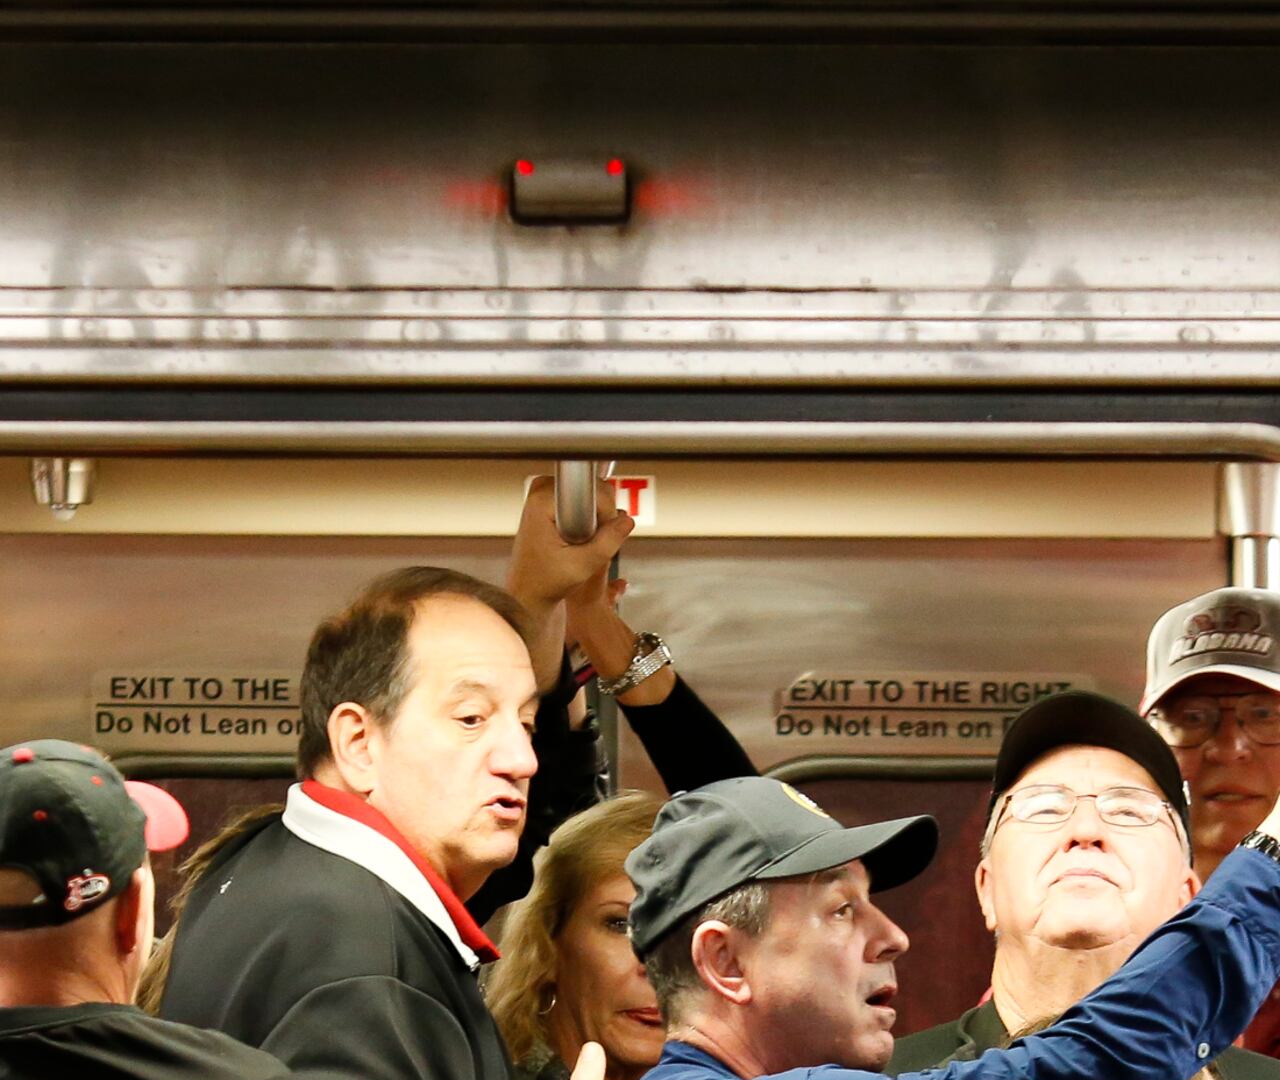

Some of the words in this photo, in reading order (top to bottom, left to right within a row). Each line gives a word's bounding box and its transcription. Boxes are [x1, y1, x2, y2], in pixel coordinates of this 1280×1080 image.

[110, 676, 174, 698] EXIT
[183, 677, 223, 699] TO
[232, 678, 290, 700] THE
[789, 679, 854, 702] EXIT
[864, 680, 904, 702] TO
[914, 681, 971, 703] THE
[95, 711, 133, 734] Do
[143, 712, 191, 734] Not
[201, 713, 267, 735] Lean
[775, 714, 813, 736] Do
[823, 714, 870, 737] Not
[880, 715, 948, 738] Lean
[956, 720, 992, 738] on
